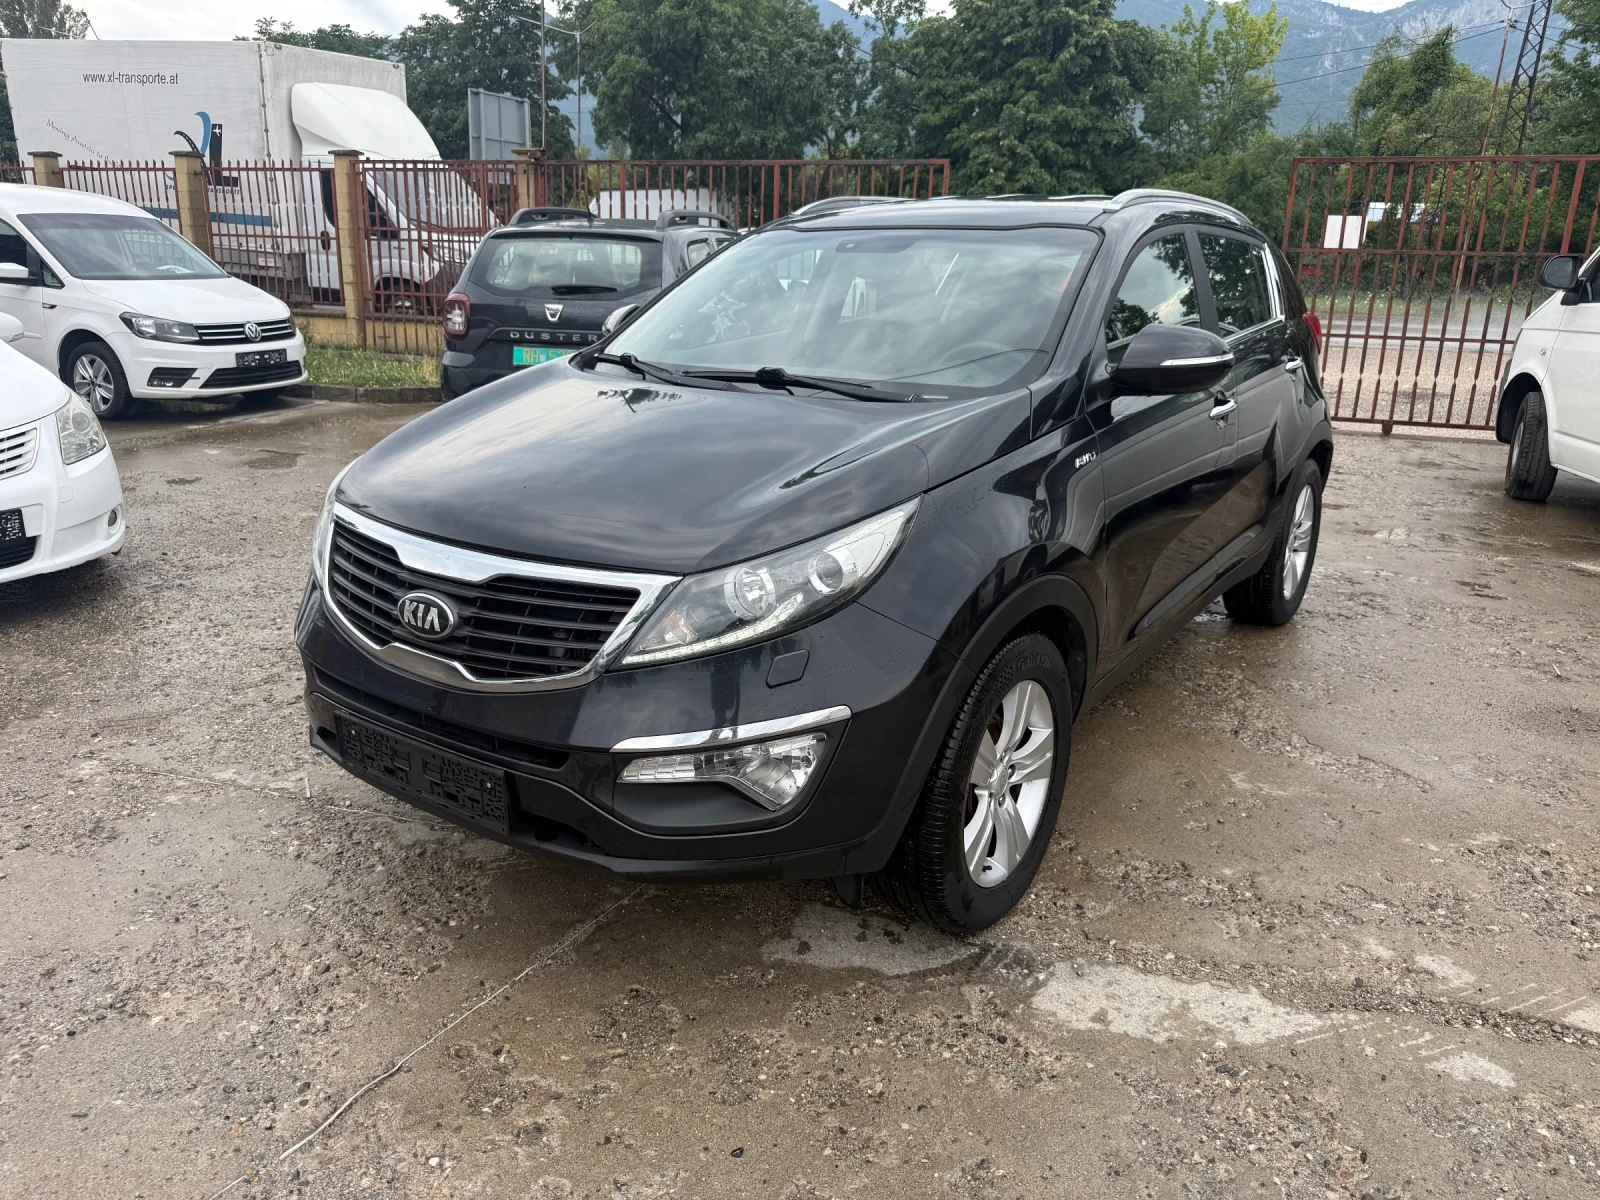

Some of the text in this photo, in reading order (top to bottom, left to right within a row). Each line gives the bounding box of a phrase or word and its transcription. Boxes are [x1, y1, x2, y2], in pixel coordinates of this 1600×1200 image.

[82, 71, 179, 86] www.xl-transporte.at
[46, 118, 70, 140] Moving
[70, 136, 95, 154] Austria
[509, 331, 598, 342] DUSTER
[522, 348, 539, 364] RH
[403, 599, 441, 632] KIA
